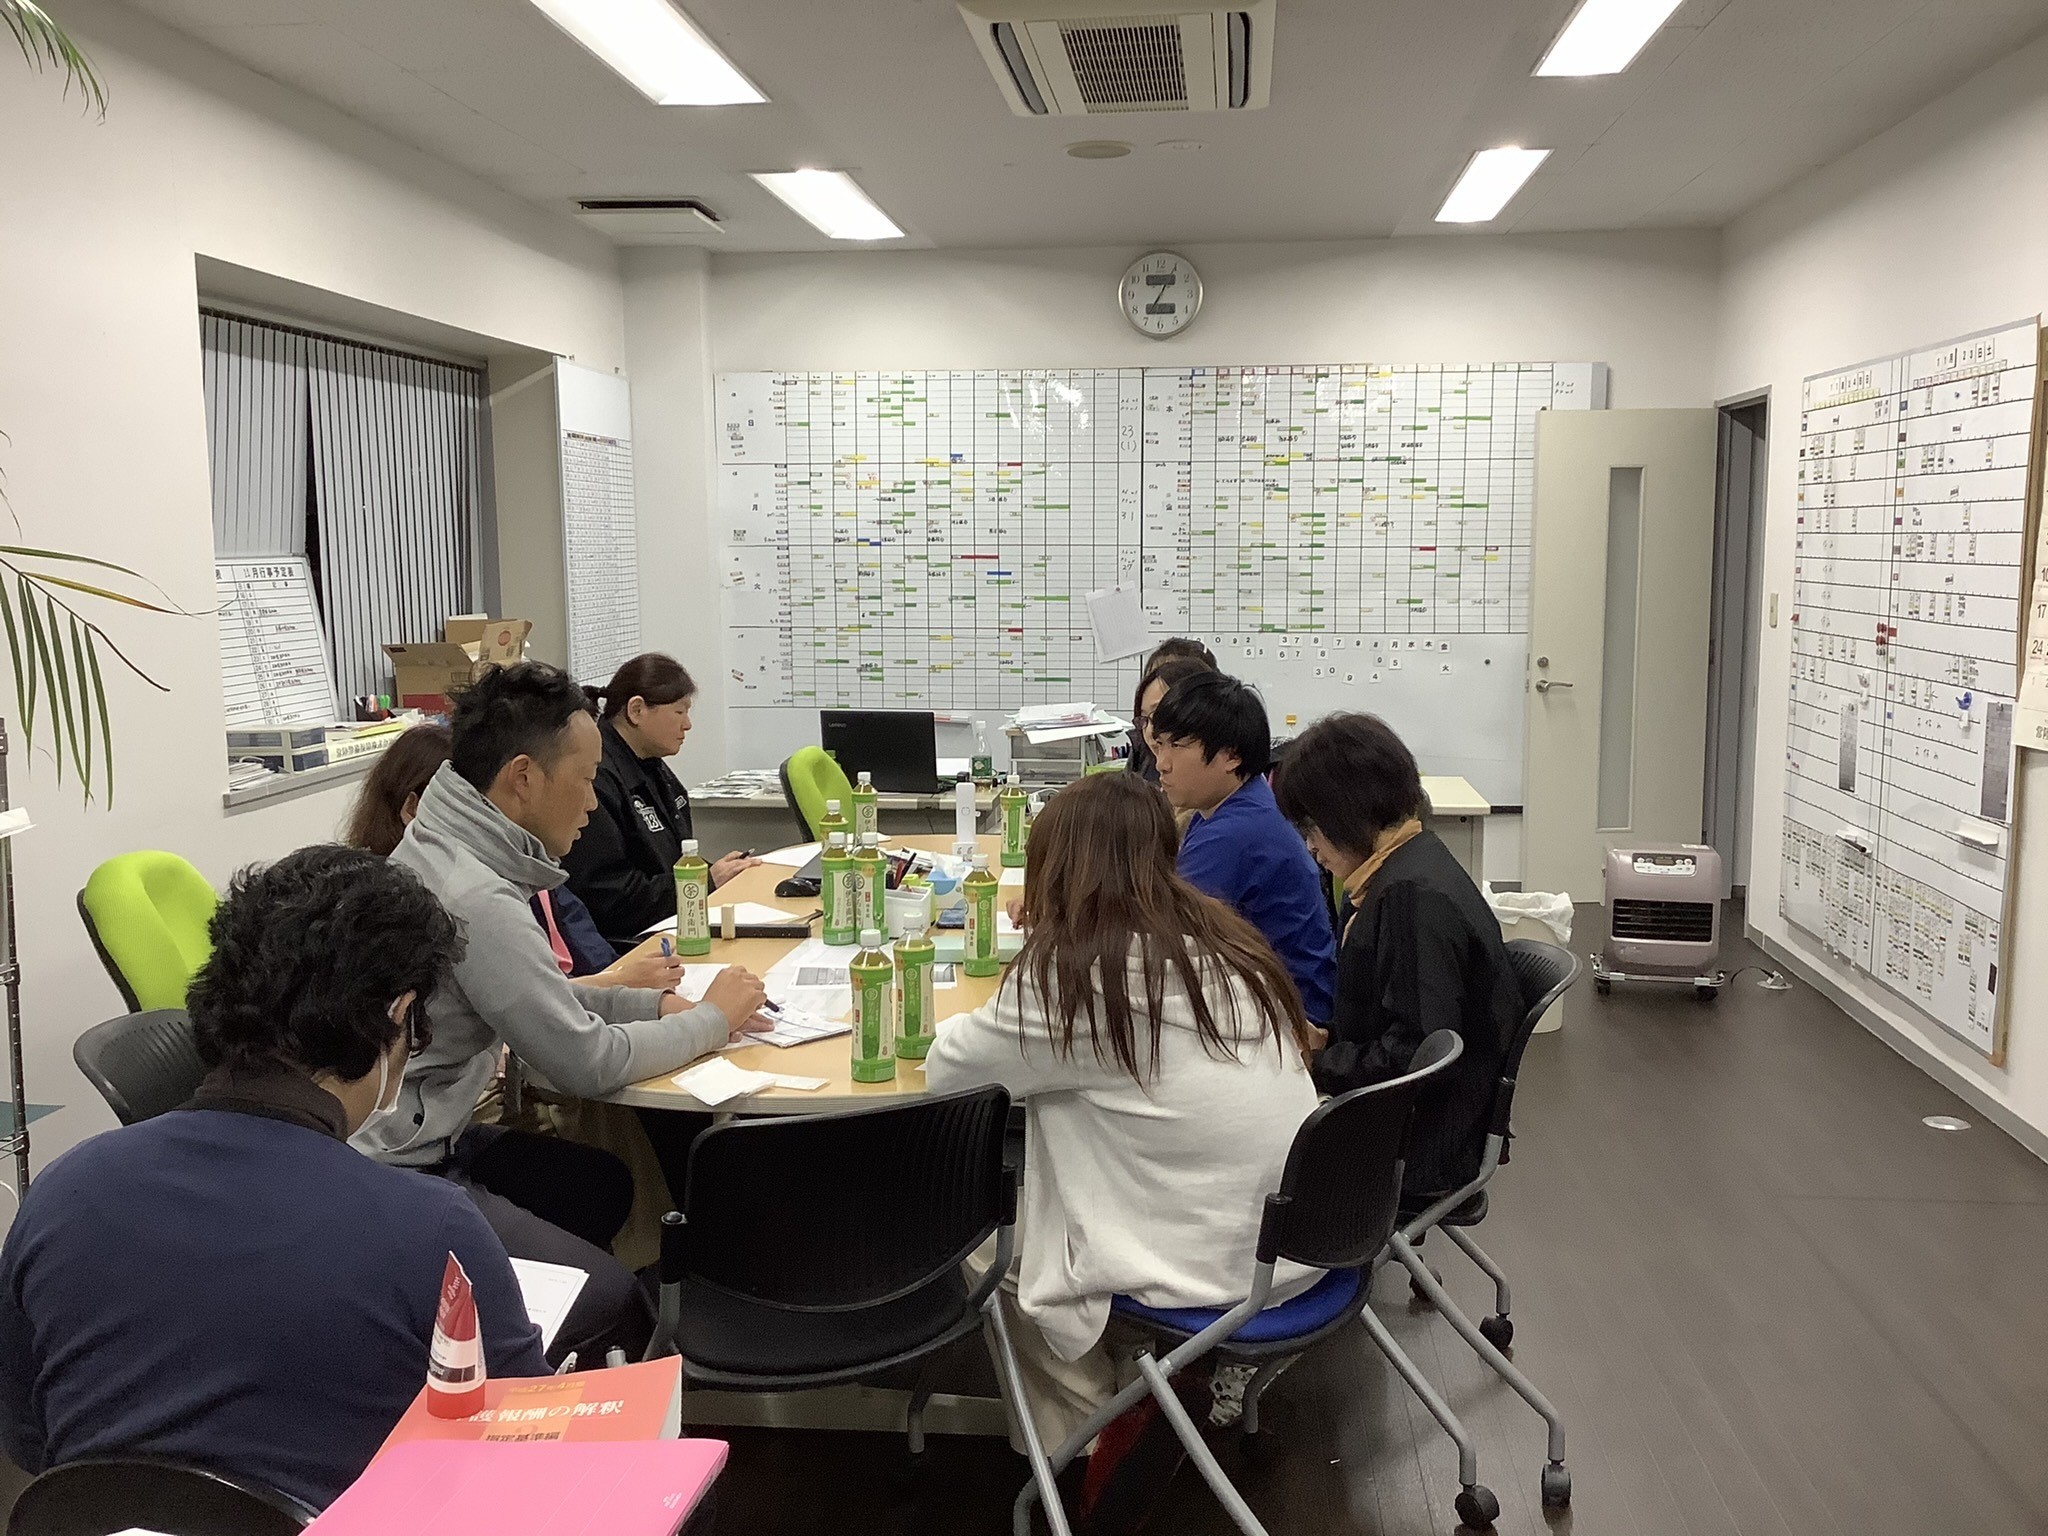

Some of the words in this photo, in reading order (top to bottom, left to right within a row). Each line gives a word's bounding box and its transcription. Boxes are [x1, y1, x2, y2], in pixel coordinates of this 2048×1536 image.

[1142, 263, 1150, 272] 11
[1156, 260, 1166, 269] 12
[1131, 275, 1140, 284] 10
[1166, 405, 1173, 413] 木
[1121, 425, 1134, 438] 23
[2037, 604, 2047, 619] 17
[2032, 639, 2043, 655] 24
[685, 885, 697, 897] 茶
[687, 900, 697, 935] 伊右衛門
[457, 1400, 625, 1424] 護報酬の解釈
